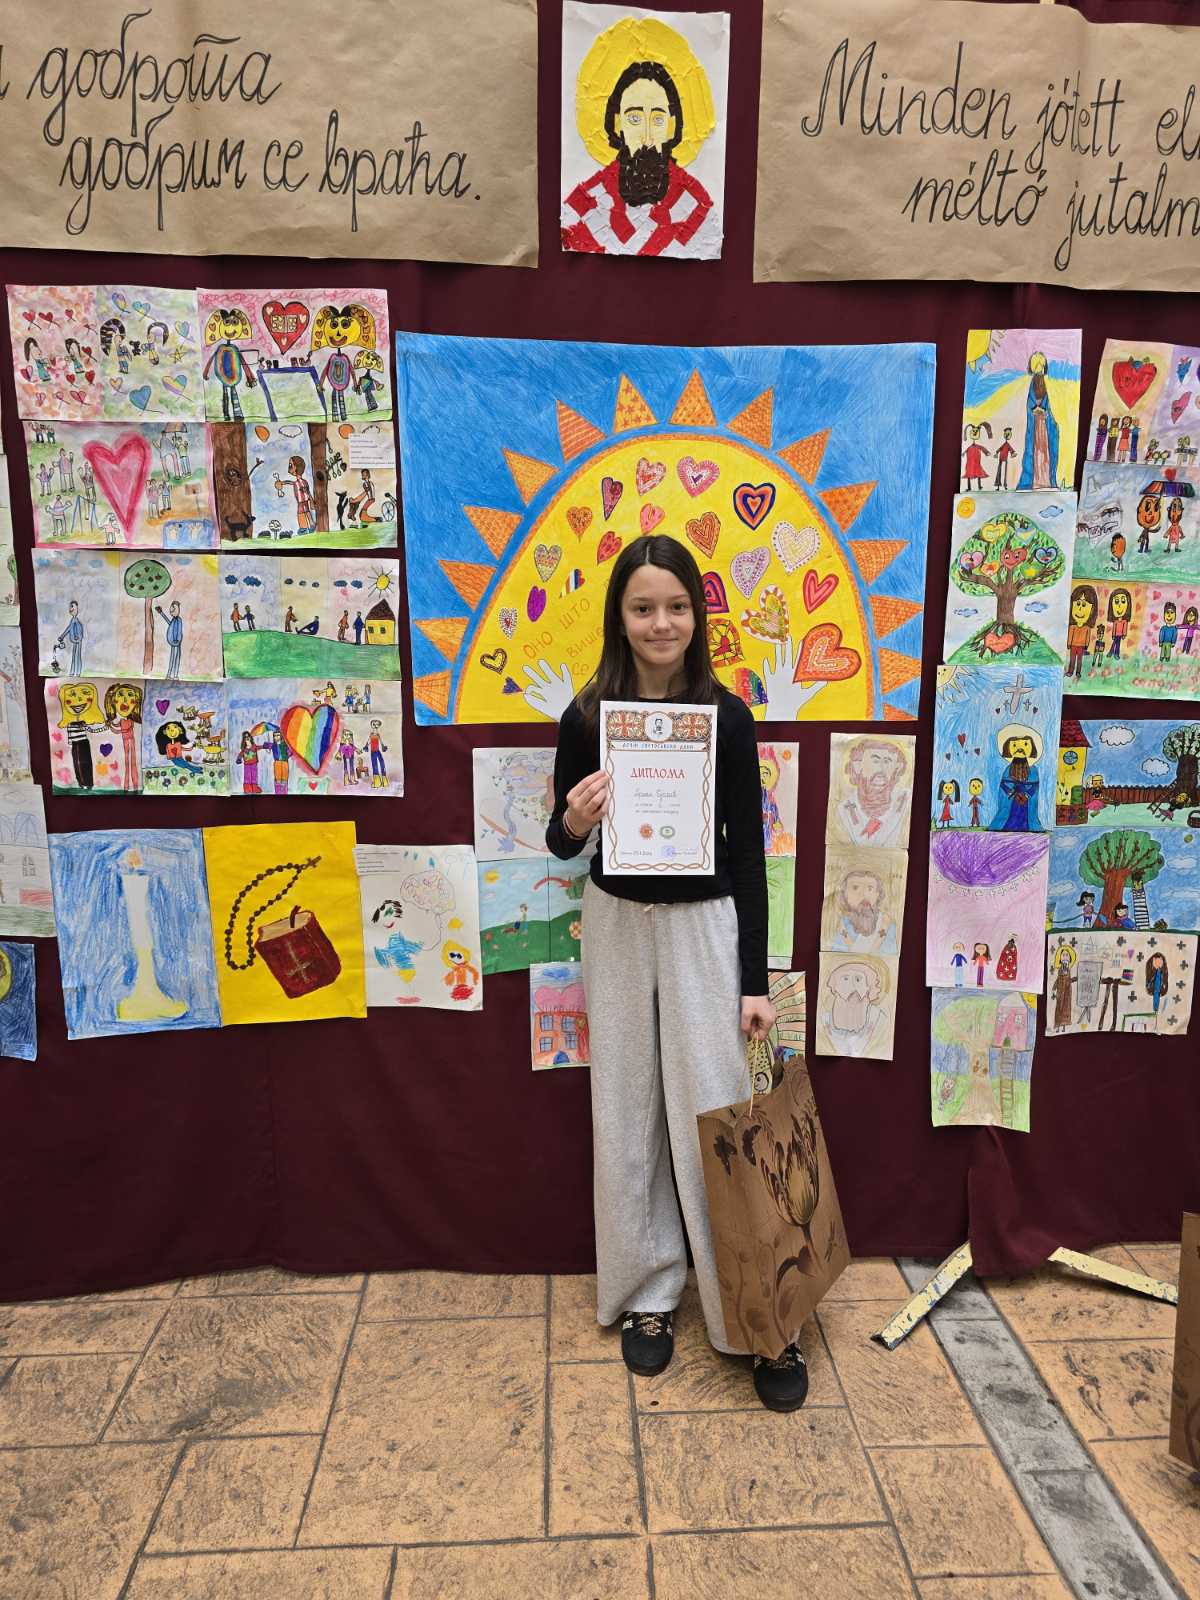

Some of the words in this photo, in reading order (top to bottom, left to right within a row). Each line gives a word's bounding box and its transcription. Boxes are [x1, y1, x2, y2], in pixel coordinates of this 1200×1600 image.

[27, 8, 282, 145] доброта
[801, 38, 1017, 140] Minden
[1025, 70, 1125, 174] jótett
[1155, 84, 1200, 162] el
[59, 105, 247, 235] добрим
[263, 139, 309, 192] се
[319, 110, 481, 232] враћа.
[901, 148, 1048, 227] méltó
[559, 597, 590, 631] ШТО
[630, 767, 686, 779] ДИПЛОМА
